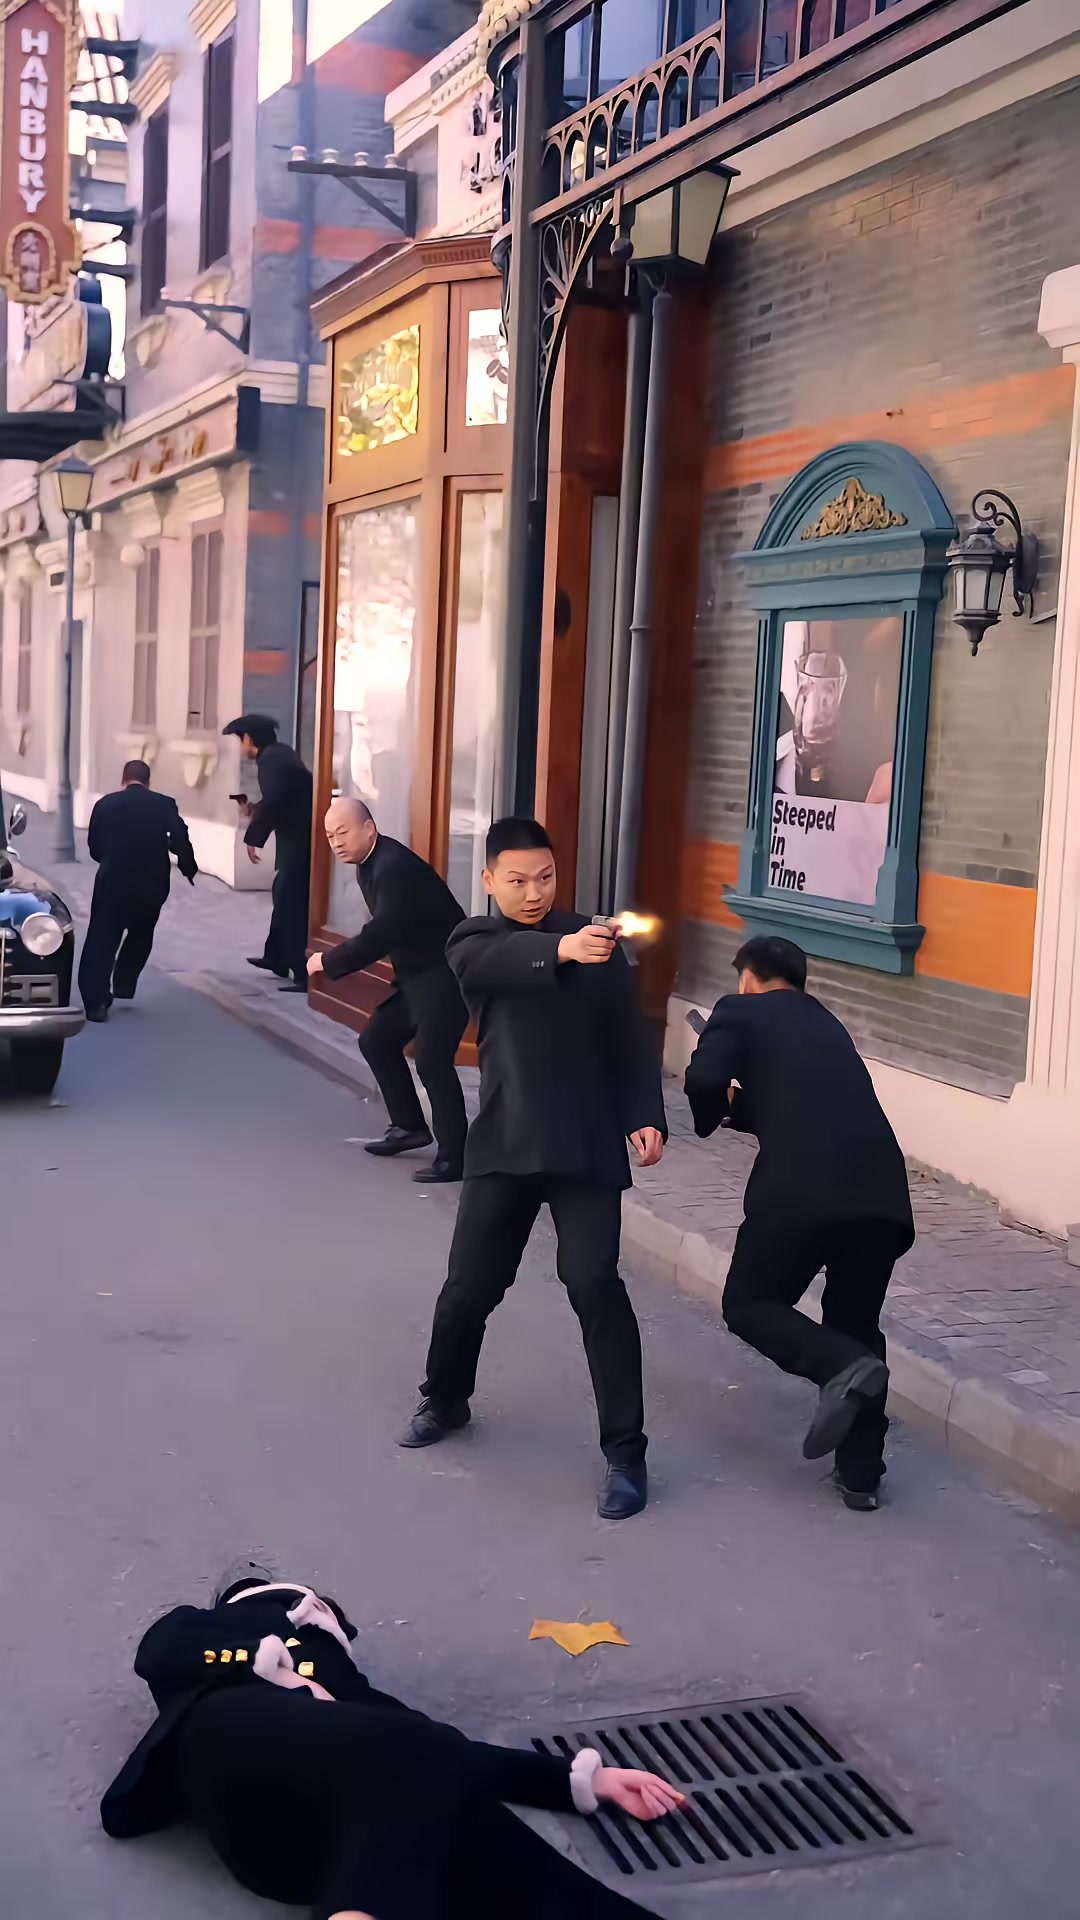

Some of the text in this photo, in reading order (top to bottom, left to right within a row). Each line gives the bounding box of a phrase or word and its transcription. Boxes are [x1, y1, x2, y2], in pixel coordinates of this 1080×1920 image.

[19, 28, 49, 213] HANBURY
[773, 800, 837, 834] Steeped
[771, 826, 786, 855] in
[770, 859, 806, 891] Time
